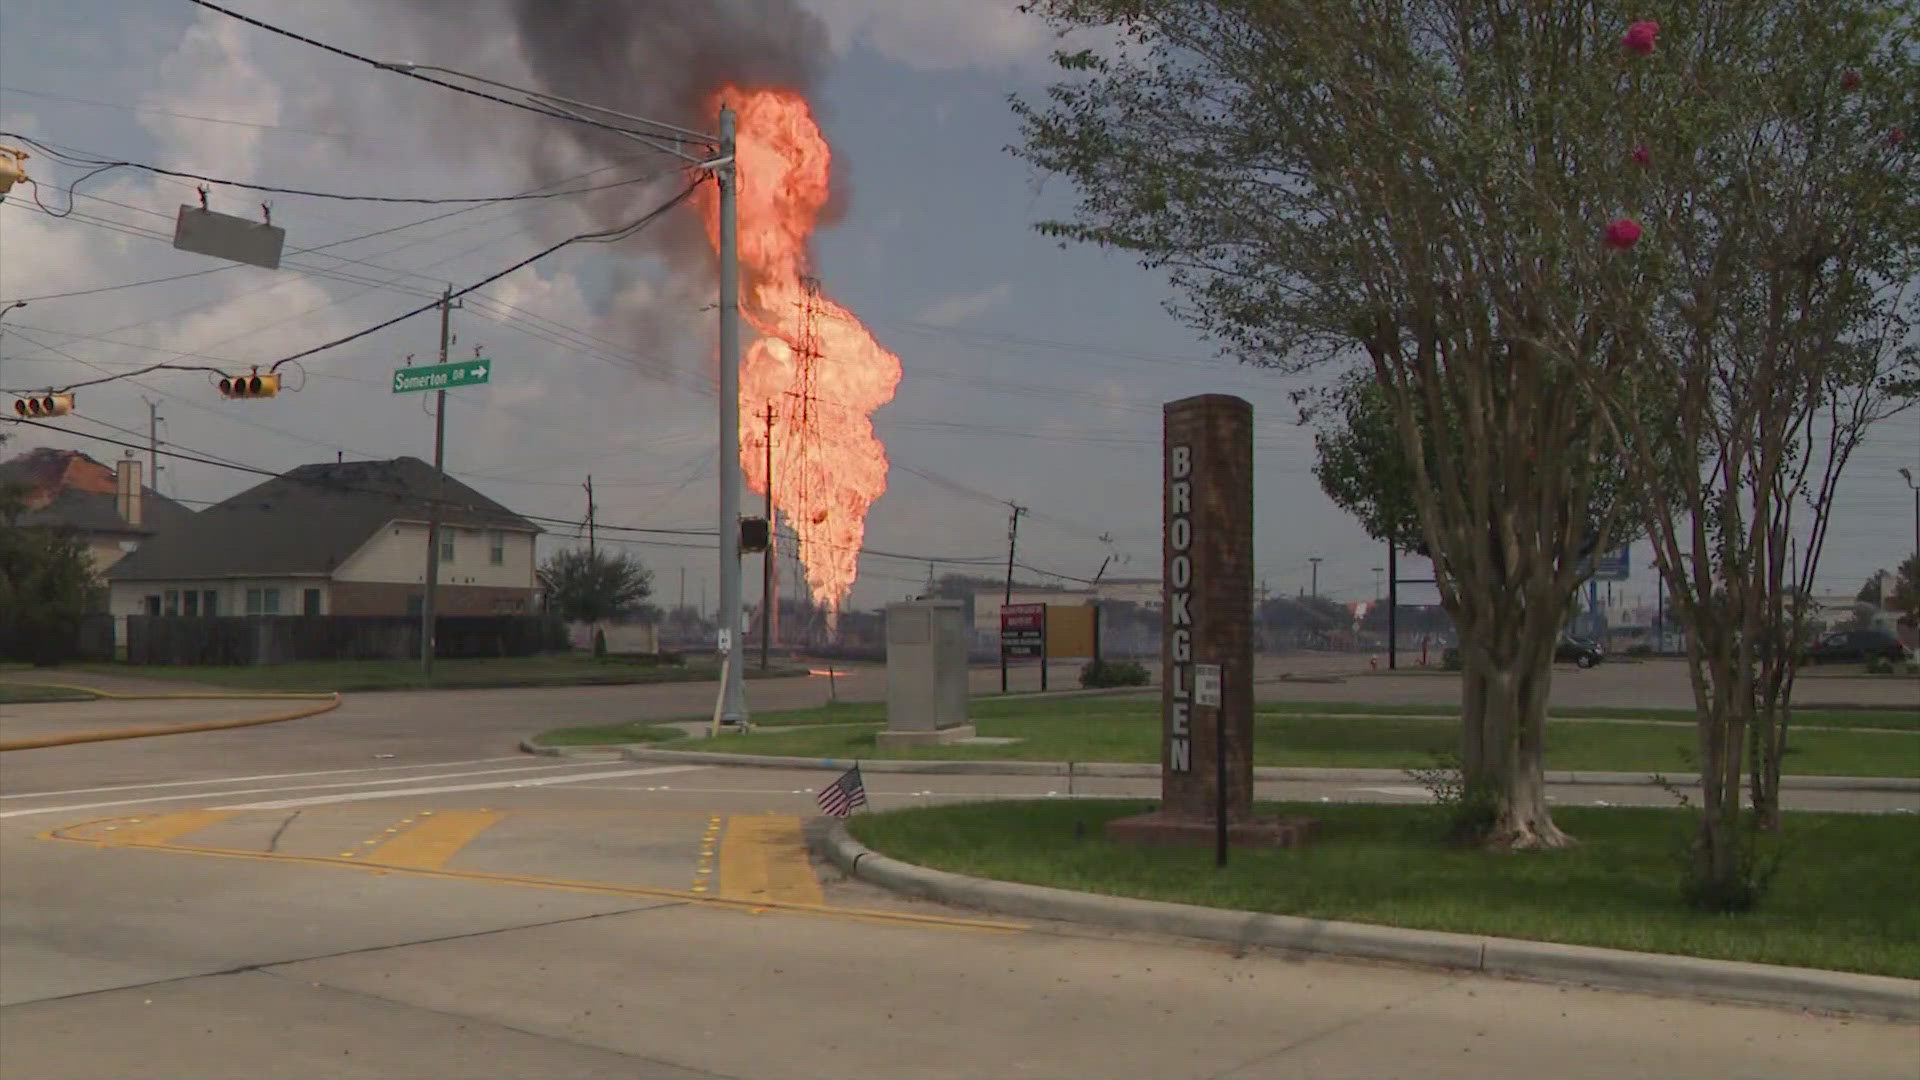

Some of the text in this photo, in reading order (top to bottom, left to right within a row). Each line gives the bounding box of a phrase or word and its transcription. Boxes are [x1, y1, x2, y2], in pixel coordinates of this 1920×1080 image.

[395, 369, 465, 390] Somerton DR
[1171, 446, 1192, 772] BROOKGLEN
